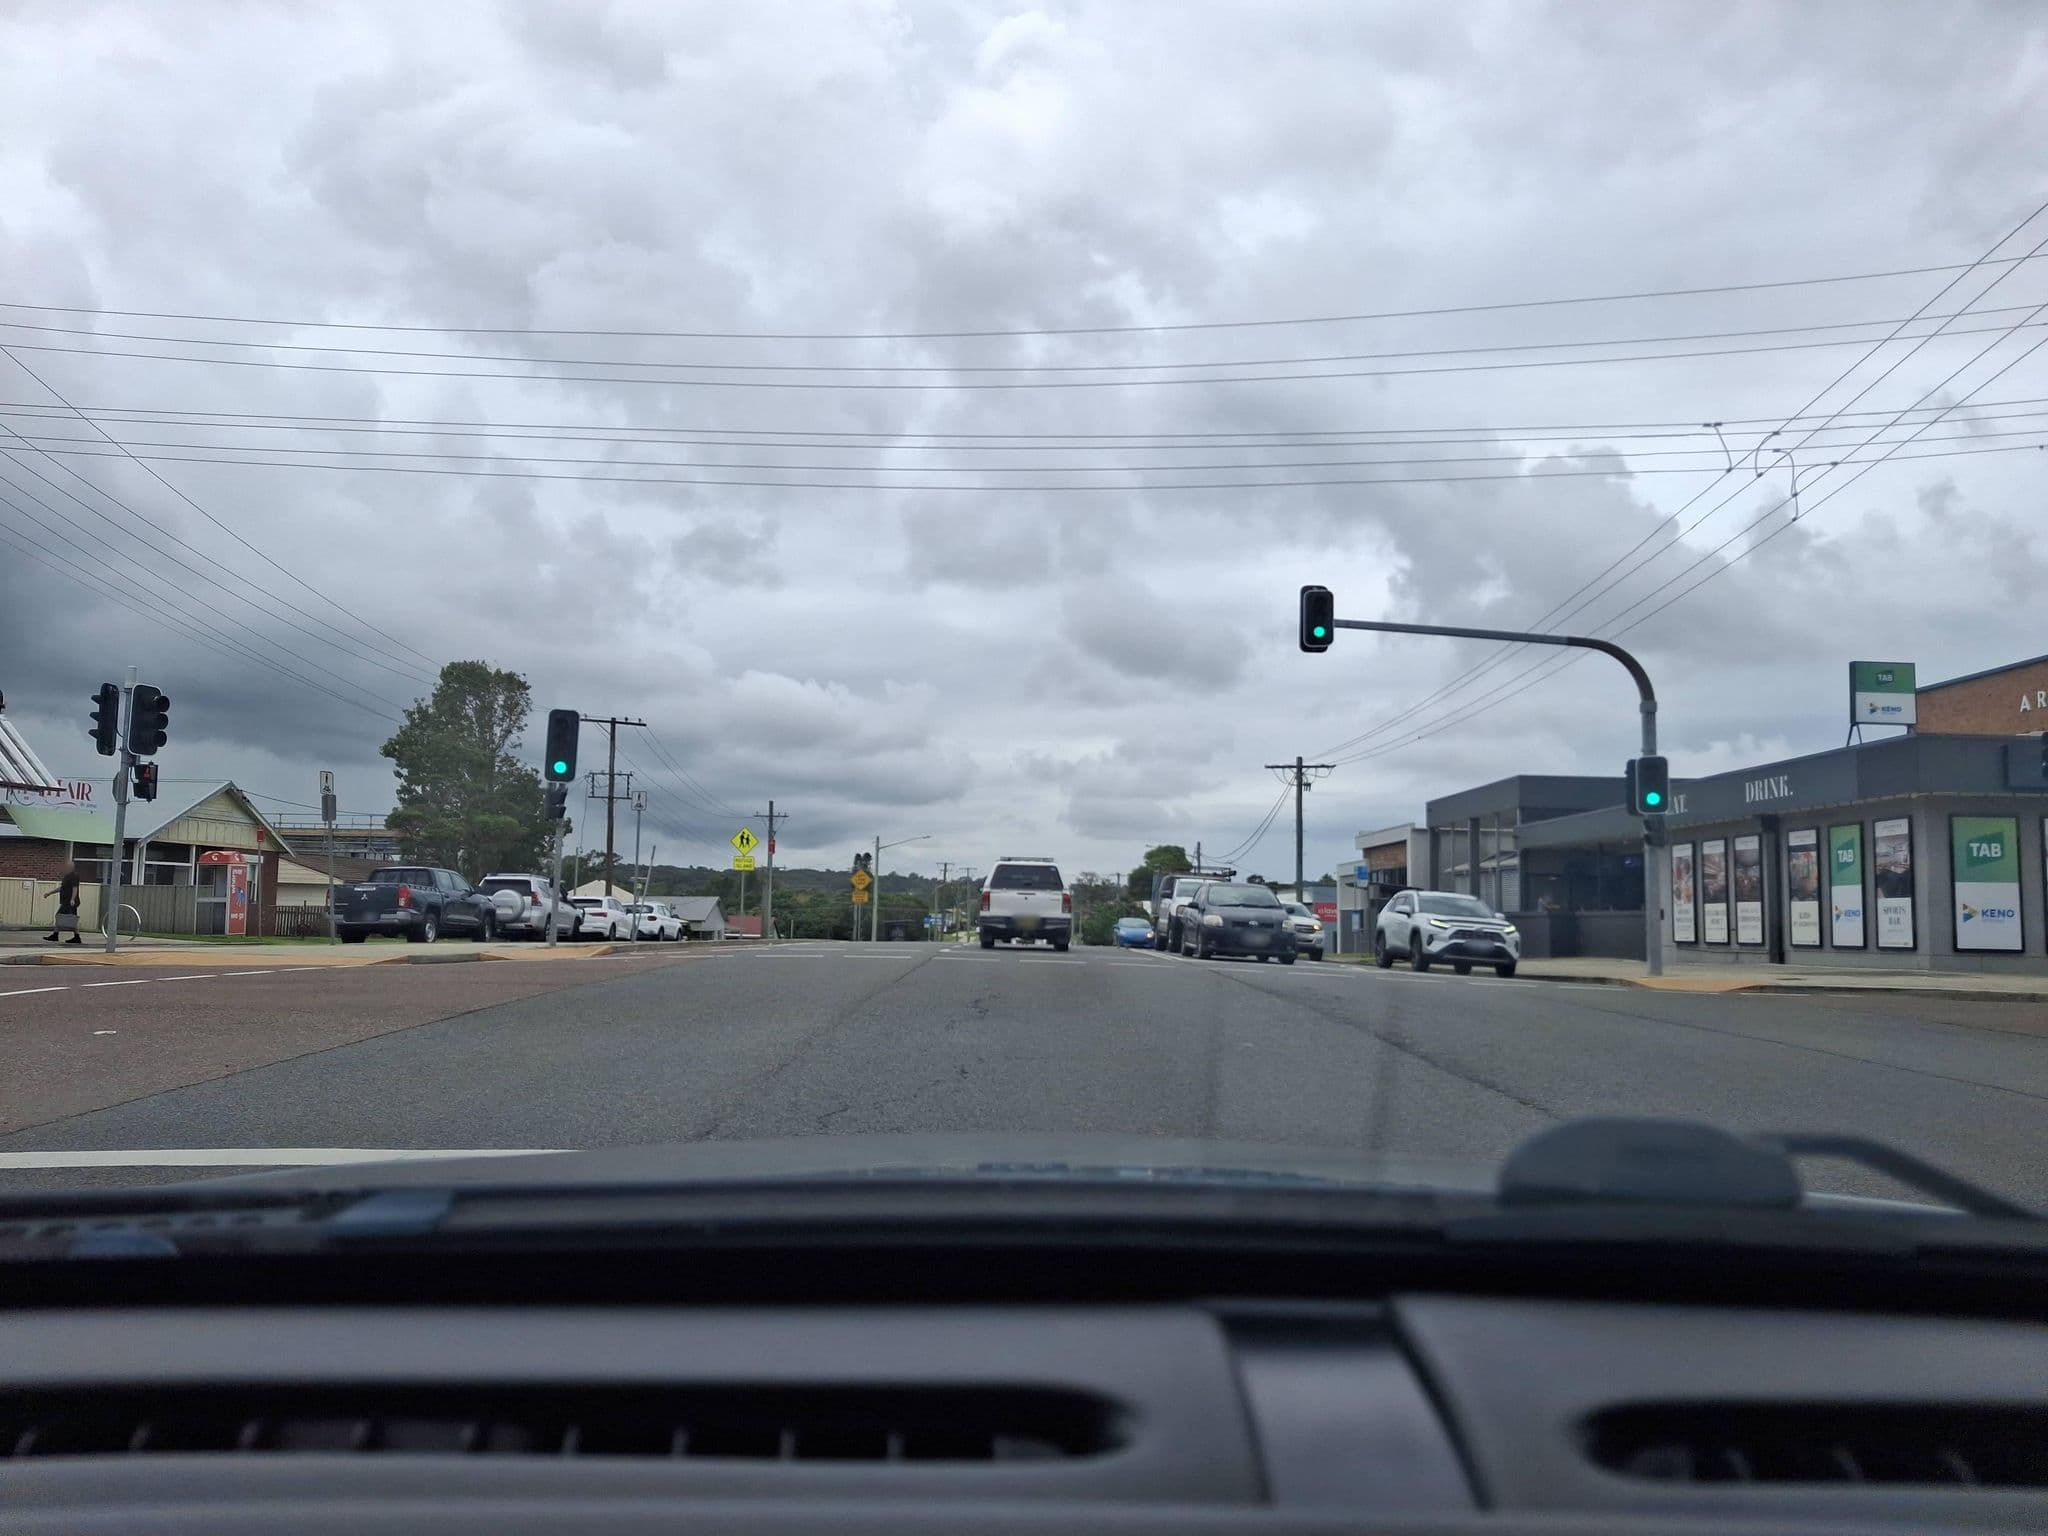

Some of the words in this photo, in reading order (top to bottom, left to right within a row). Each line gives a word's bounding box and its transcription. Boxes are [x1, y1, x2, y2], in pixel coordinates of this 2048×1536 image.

[1837, 849, 1854, 863] TAB
[1968, 842, 2003, 858] TAB
[1981, 908, 2015, 918] KENO
